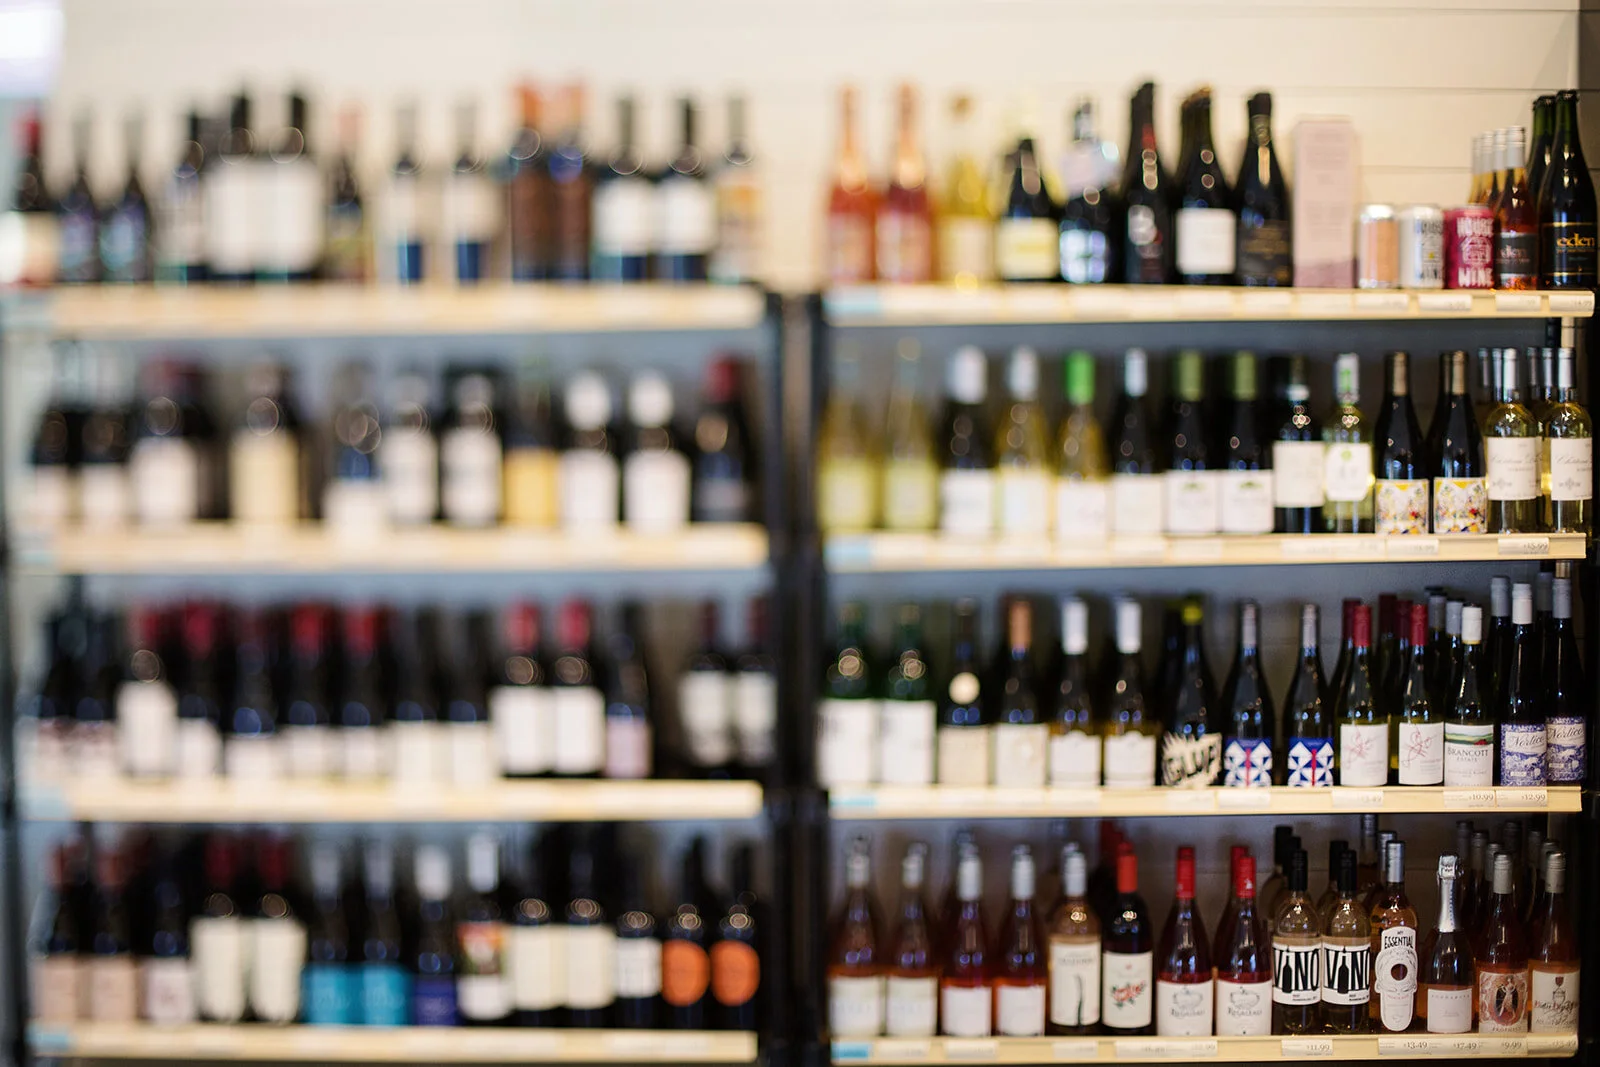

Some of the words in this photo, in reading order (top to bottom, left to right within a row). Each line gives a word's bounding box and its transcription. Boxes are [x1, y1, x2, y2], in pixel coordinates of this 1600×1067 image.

[1457, 216, 1494, 237] HOUSE
[1556, 232, 1595, 247] eden
[1458, 266, 1493, 289] WINE
[1447, 746, 1489, 757] BRANCOTT
[1384, 936, 1414, 949] ESSENTIAL
[1272, 948, 1320, 993] VINO
[1325, 947, 1371, 995] VINO
